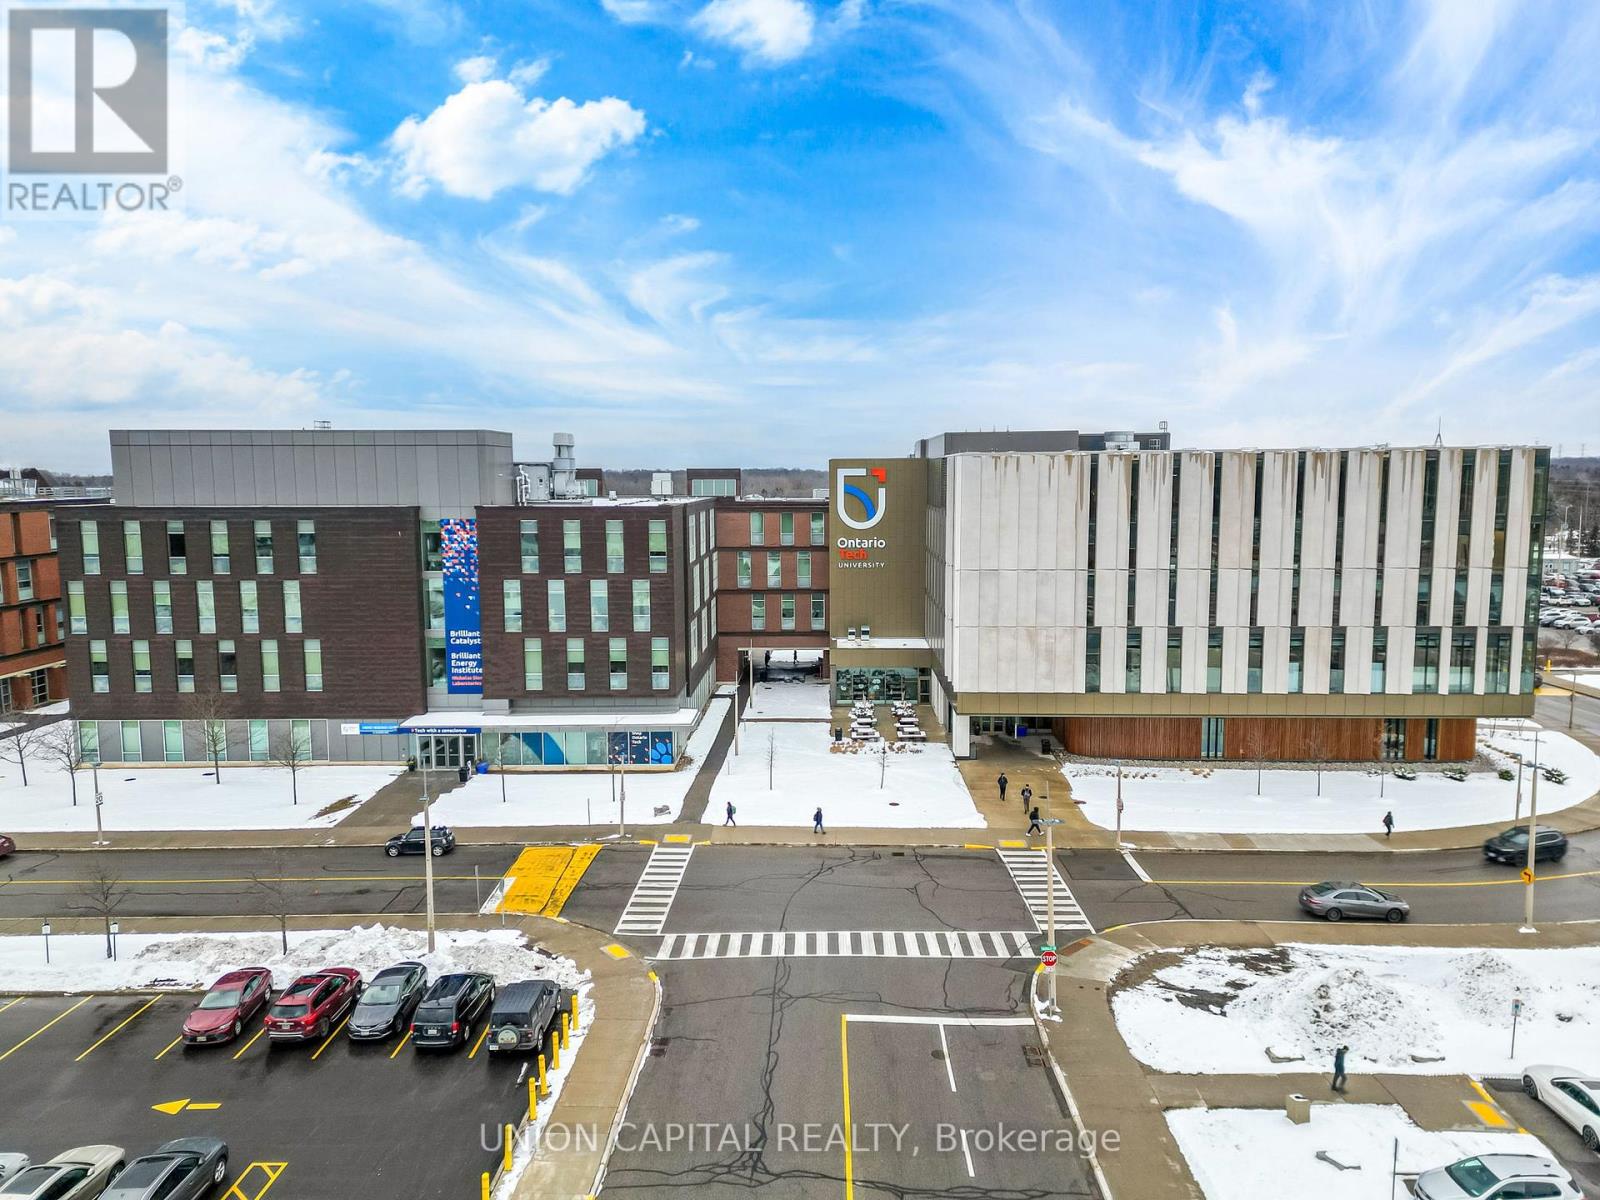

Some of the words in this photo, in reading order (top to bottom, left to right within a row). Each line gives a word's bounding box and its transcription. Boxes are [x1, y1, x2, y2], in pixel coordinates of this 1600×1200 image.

[837, 537, 886, 548] Ontario
[839, 548, 868, 560] Tech
[450, 637, 481, 645] Catalyst
